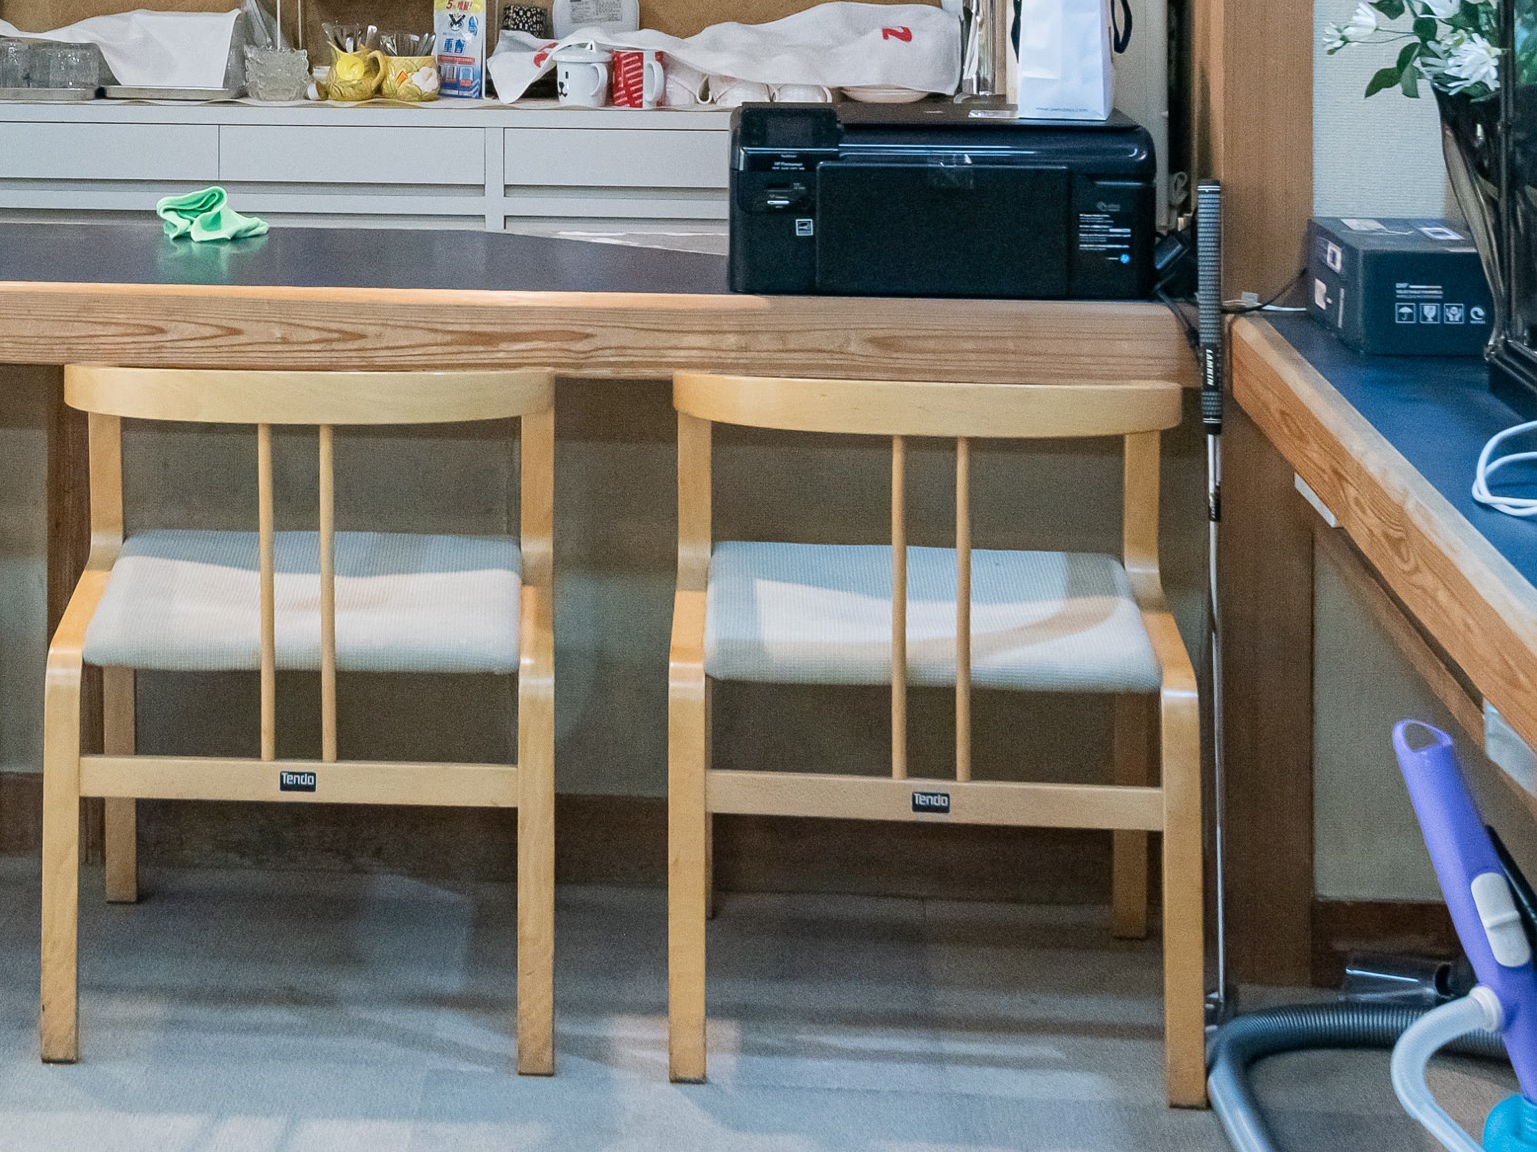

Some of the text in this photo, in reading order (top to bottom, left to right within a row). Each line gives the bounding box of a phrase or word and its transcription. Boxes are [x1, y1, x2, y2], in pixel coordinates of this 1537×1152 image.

[1206, 349, 1214, 386] LAMKIN
[281, 773, 314, 785] Tendo
[914, 793, 948, 806] Tendo
